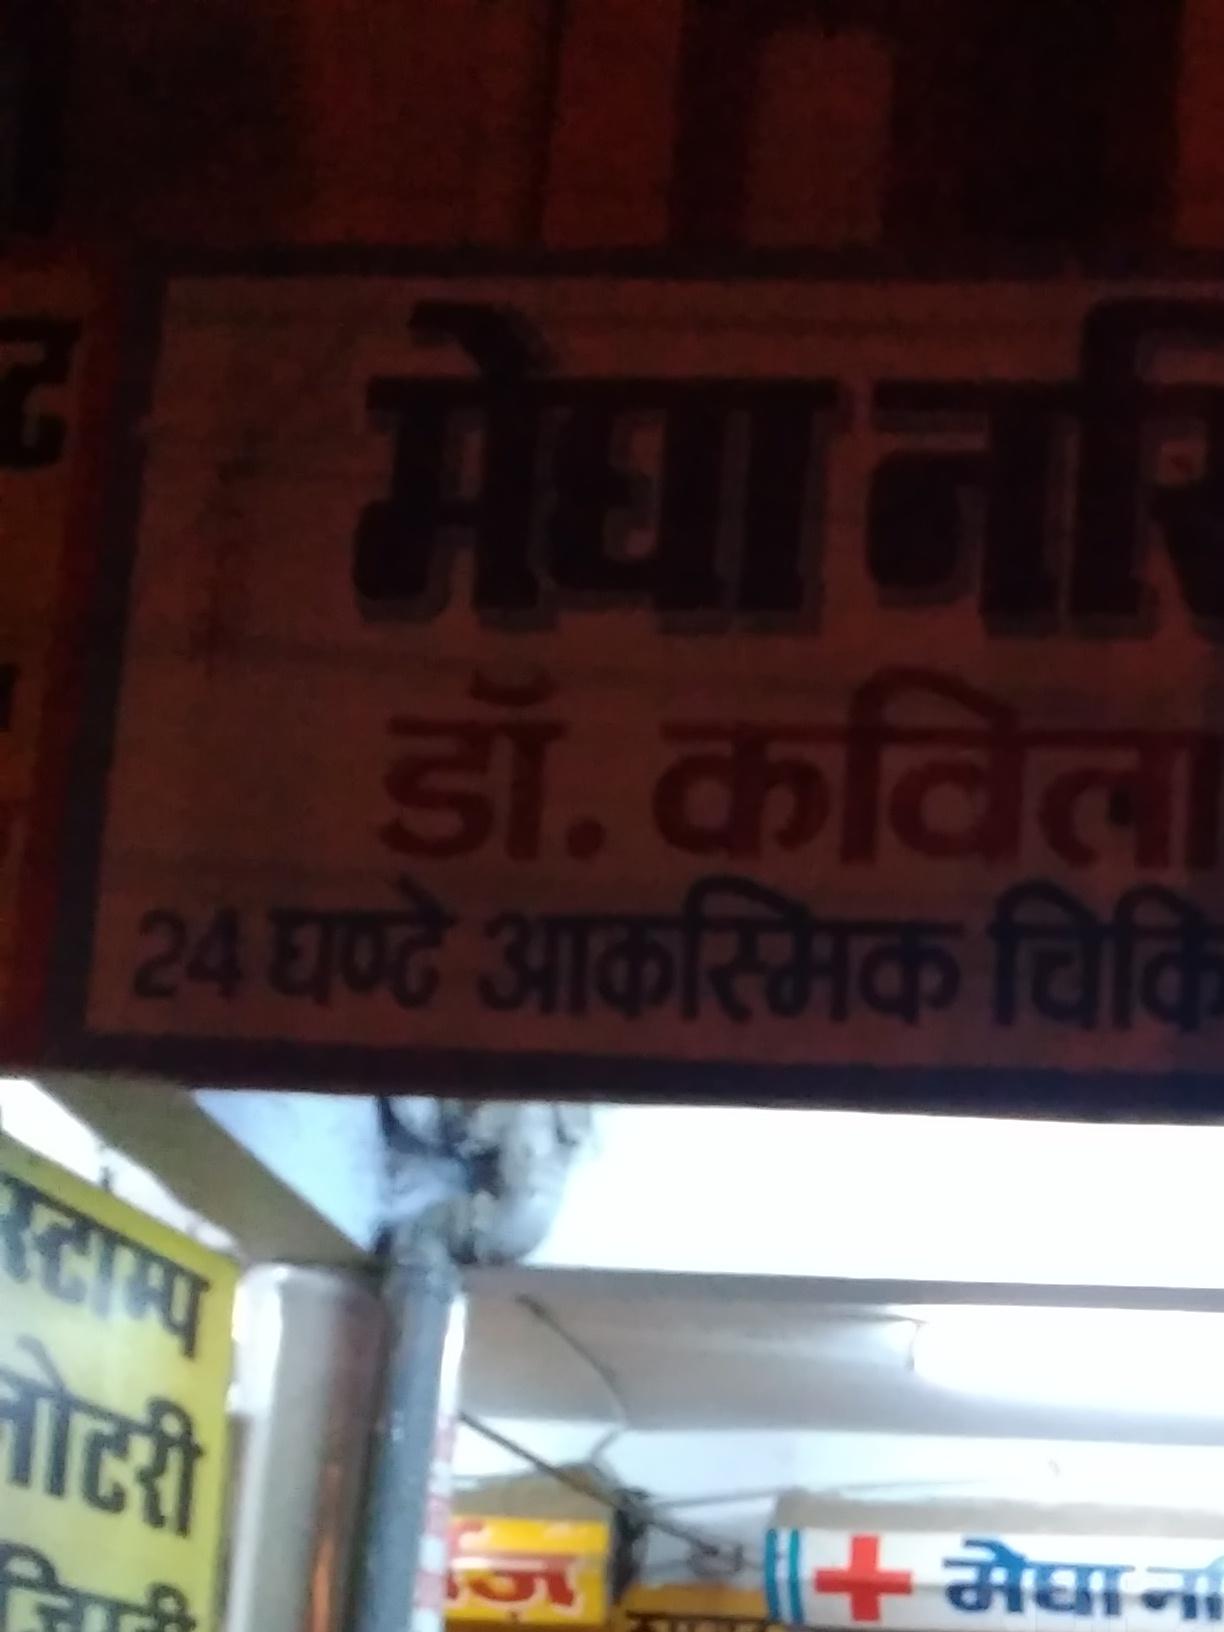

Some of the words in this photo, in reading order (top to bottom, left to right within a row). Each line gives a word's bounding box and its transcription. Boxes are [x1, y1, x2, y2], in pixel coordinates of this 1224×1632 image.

[352, 300, 845, 632] मेघा
[378, 668, 608, 863] डॉ.
[132, 908, 242, 1000] 24
[266, 874, 462, 1008] घण्टे
[475, 876, 964, 1024] आकस्मिक
[942, 1538, 1136, 1620] मेघा
